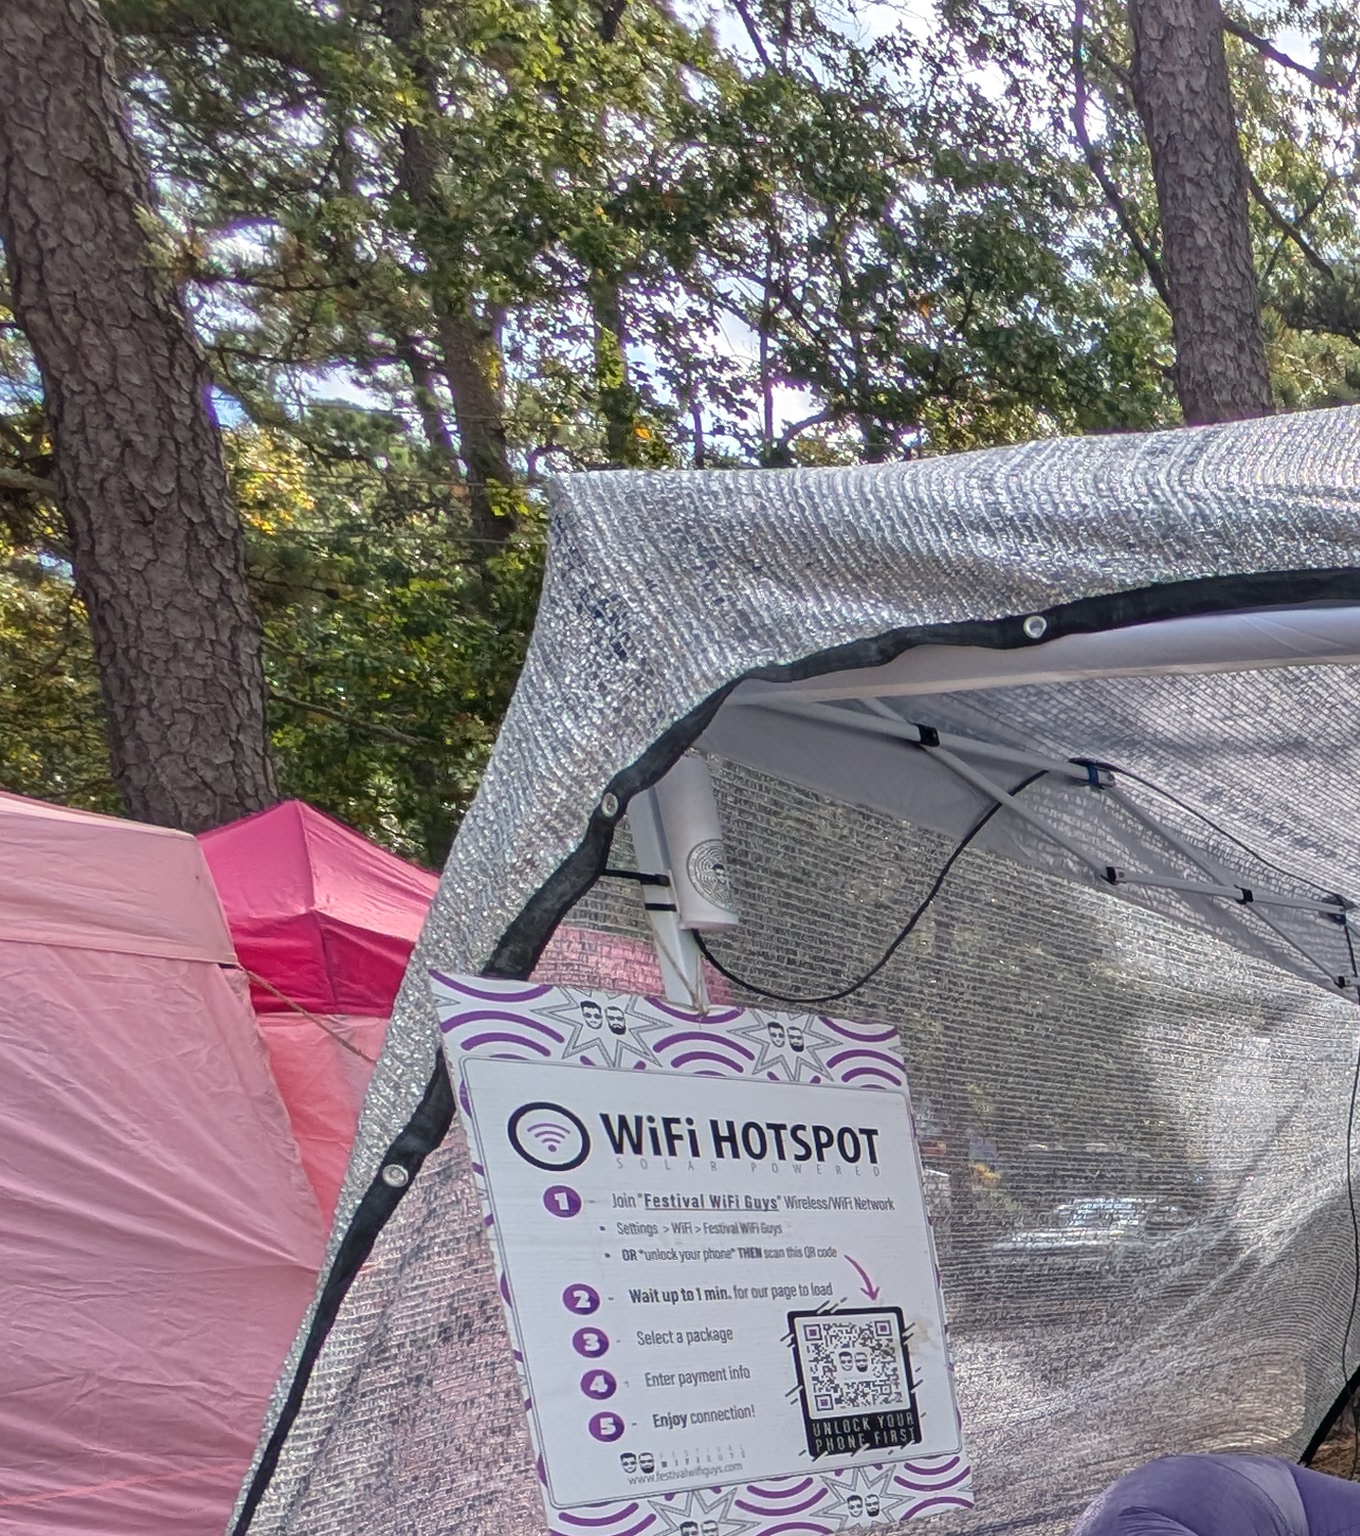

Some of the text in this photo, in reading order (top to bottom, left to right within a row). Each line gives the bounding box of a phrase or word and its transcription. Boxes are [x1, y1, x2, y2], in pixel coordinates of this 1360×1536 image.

[599, 1113, 879, 1165] WiFi HOTSPOT
[616, 1157, 881, 1178] SOLAR POWERED
[554, 1192, 570, 1211] 1
[612, 1193, 636, 1208] Join
[709, 1194, 740, 1209] WiFi
[854, 1197, 895, 1211] Network
[616, 1221, 659, 1237] Settings
[671, 1222, 691, 1234] WiFi
[704, 1222, 739, 1235] Festival
[740, 1222, 759, 1235] WiFi
[761, 1222, 782, 1236] Guys
[678, 1250, 701, 1263] your
[738, 1247, 762, 1259] THEN
[764, 1248, 786, 1259] scan
[786, 1246, 803, 1258] this
[817, 1246, 837, 1258] code
[573, 1281, 833, 1309] 2 Wait up to 1 min. for our page to load
[583, 1327, 734, 1352] 3 Select a package
[589, 1364, 751, 1393] 4 Enter payment info
[600, 1403, 756, 1436] 5 Enjoy connection!
[812, 1411, 915, 1437] UNLOCK YOUR
[815, 1427, 915, 1453] PHONE FIRST
